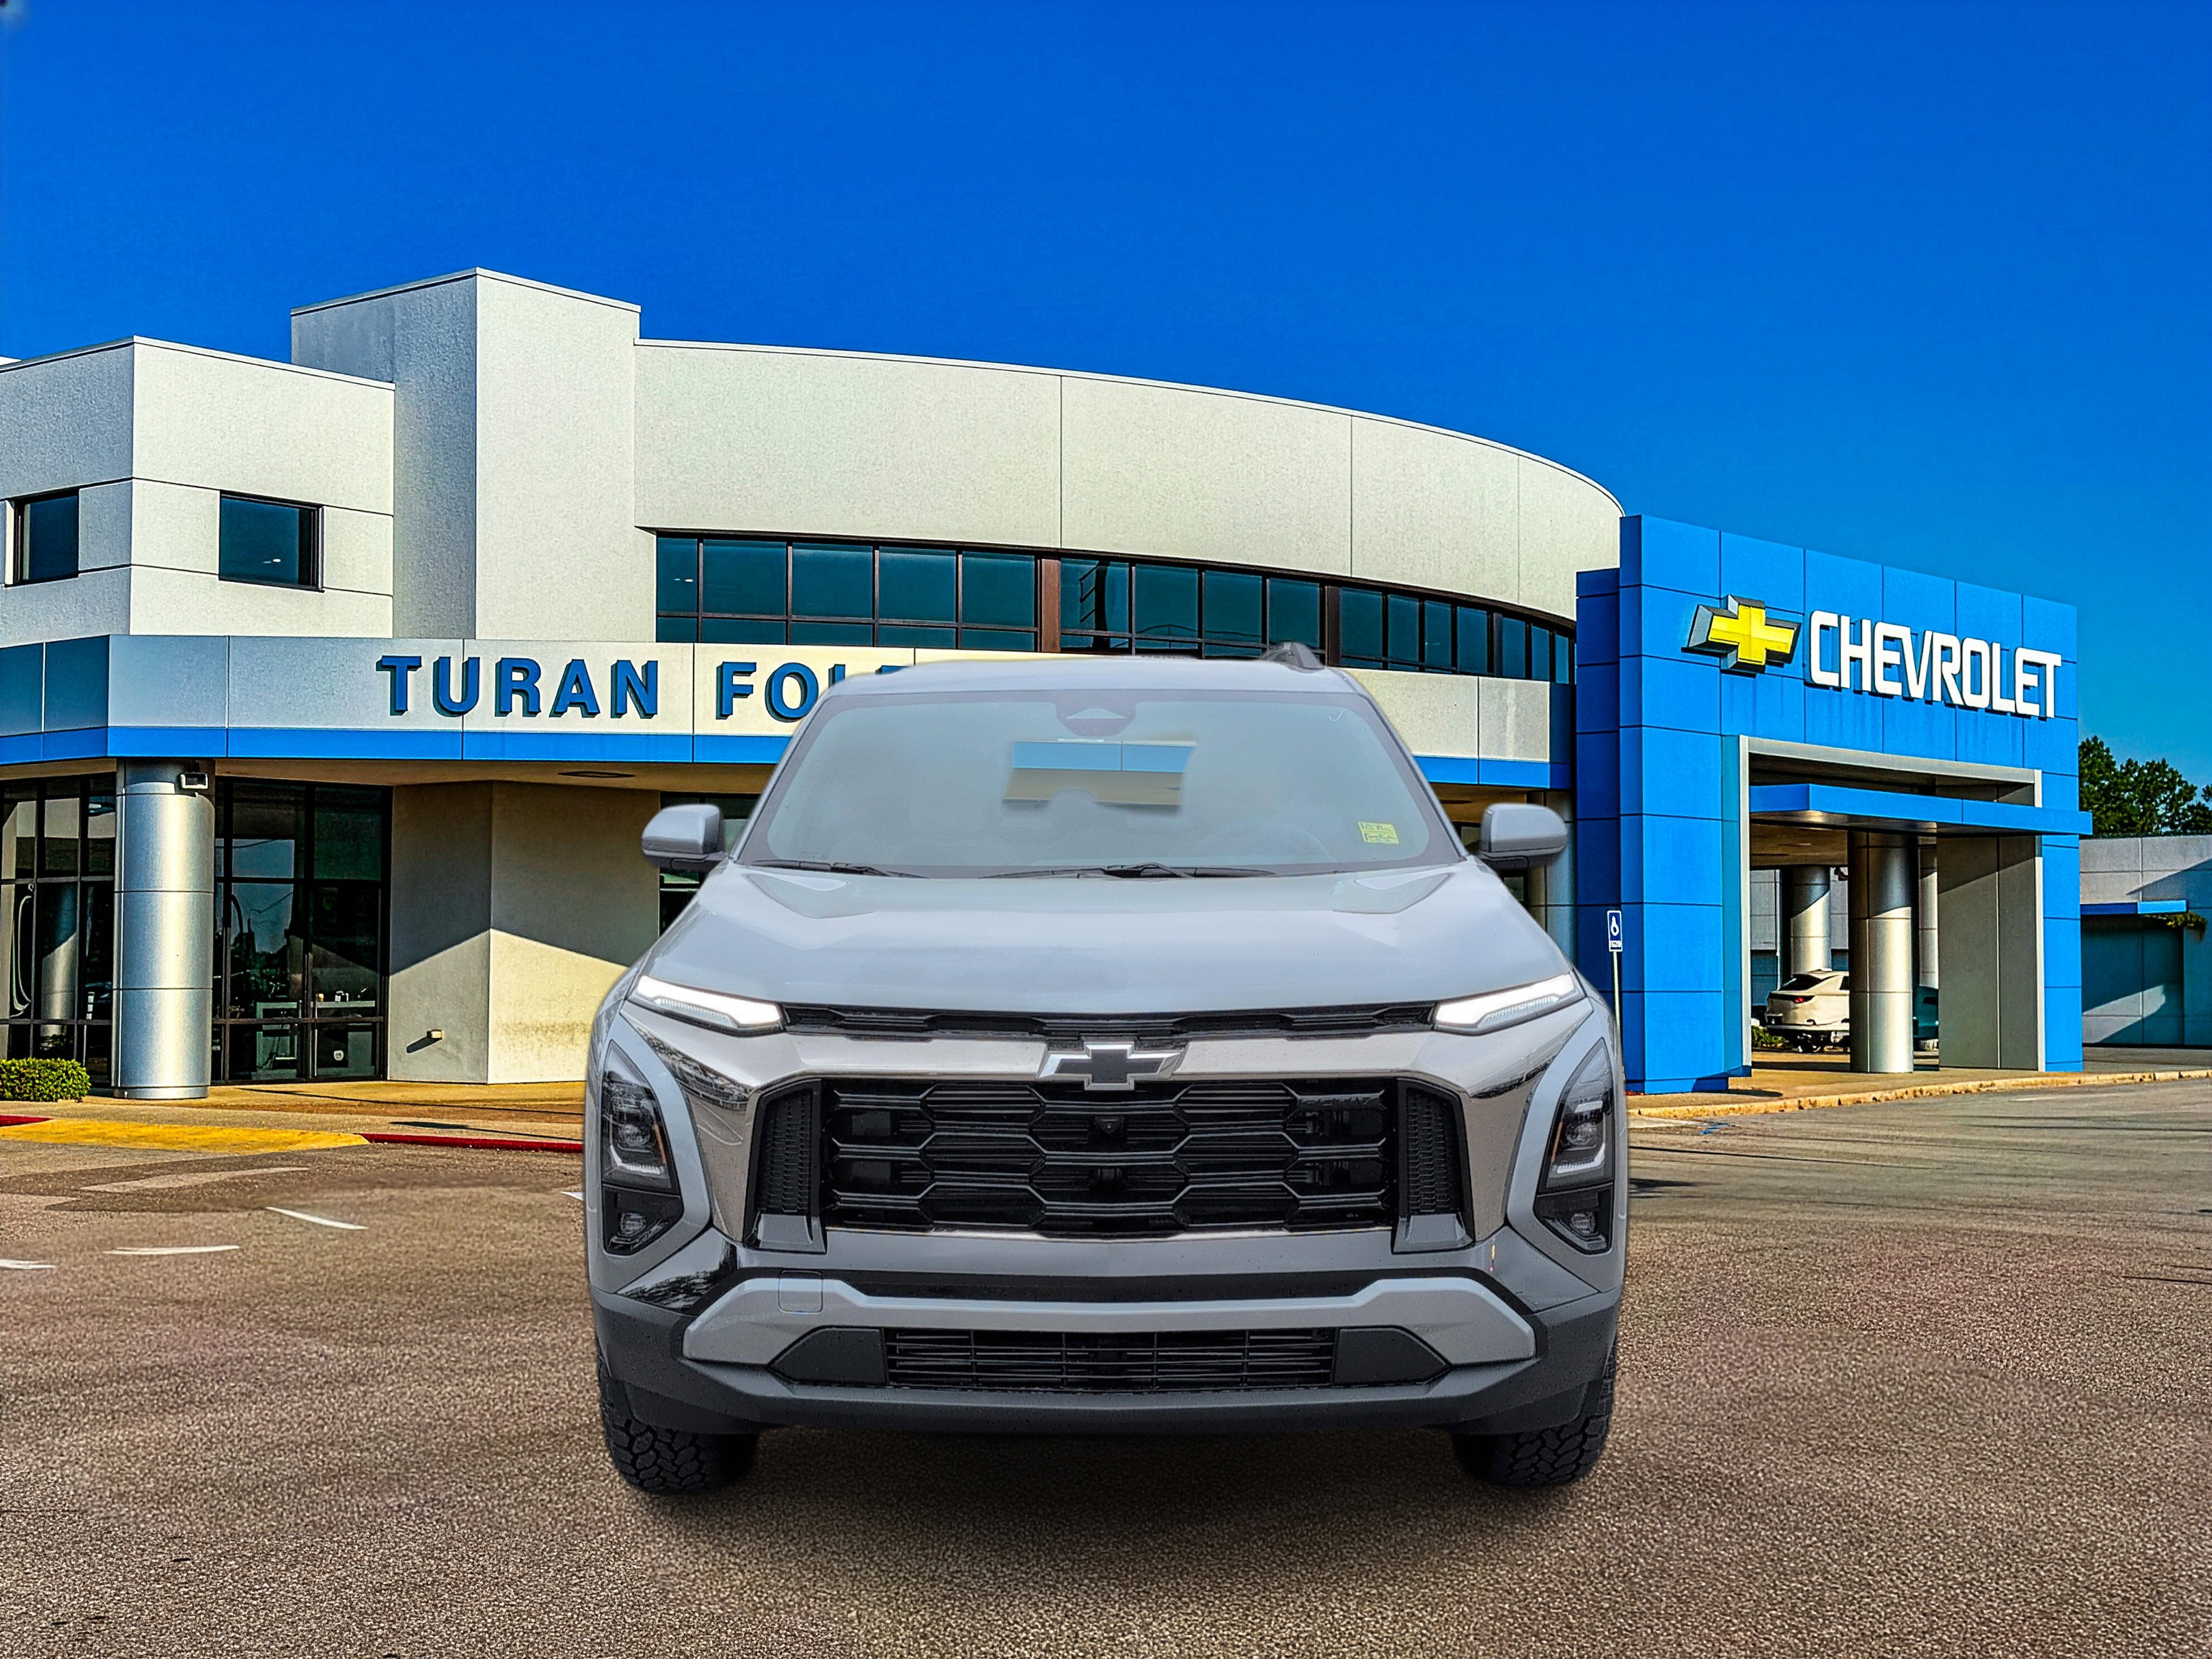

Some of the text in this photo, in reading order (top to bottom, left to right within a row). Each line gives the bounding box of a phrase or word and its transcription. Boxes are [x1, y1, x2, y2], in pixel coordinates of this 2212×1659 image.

[376, 655, 913, 723] TURAN FO
[1810, 610, 2062, 719] CHEVROLET
